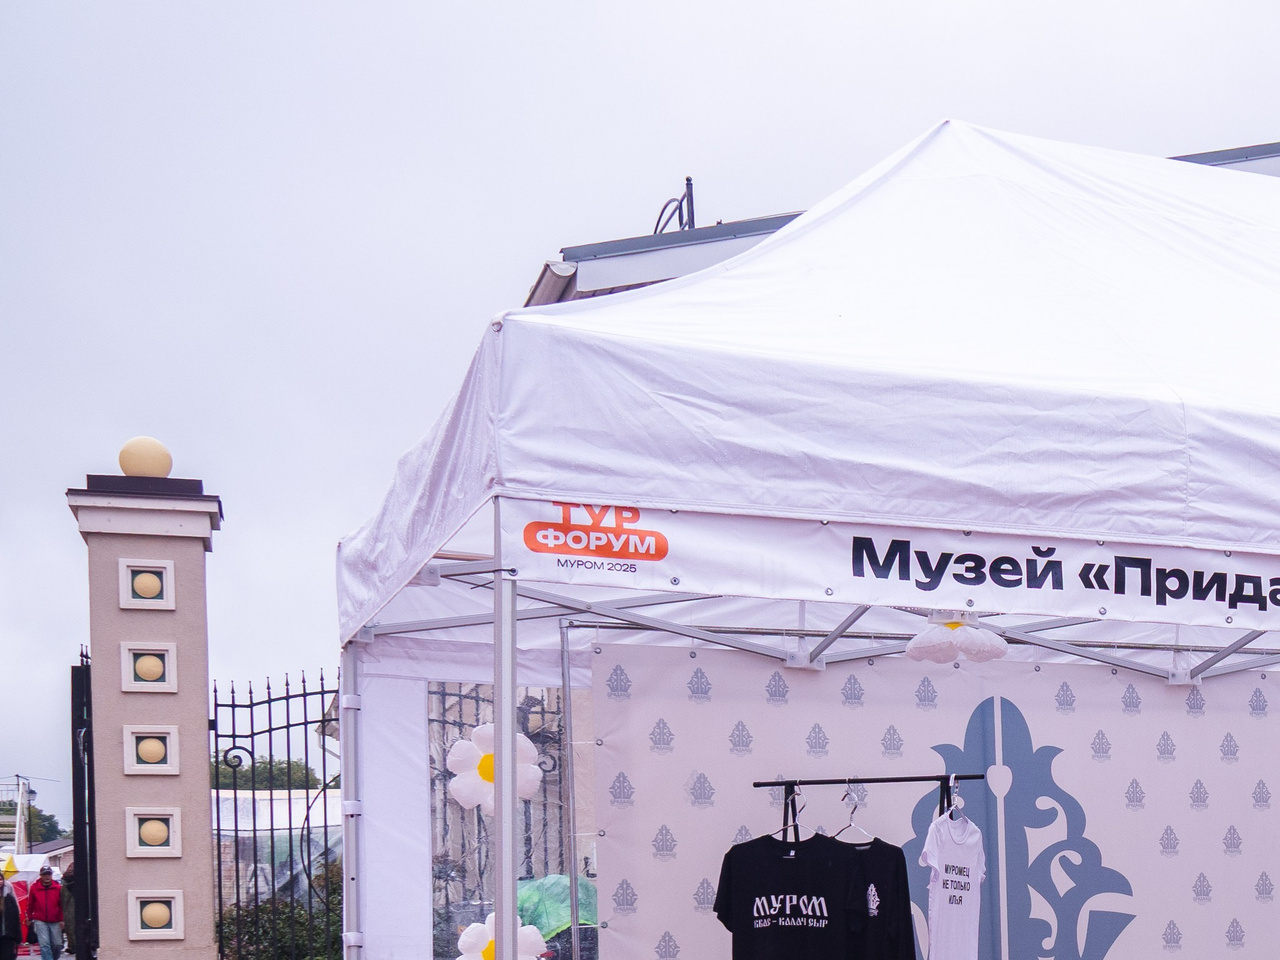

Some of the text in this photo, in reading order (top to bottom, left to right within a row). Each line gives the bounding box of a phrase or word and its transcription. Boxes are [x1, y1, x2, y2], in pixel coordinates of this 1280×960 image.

[552, 501, 641, 529] ТУР
[535, 528, 656, 554] ФОРУМ
[557, 558, 637, 573] МУРОМ 2025
[852, 536, 1064, 591] Музей
[945, 864, 970, 879] МУРОМЕЦ
[943, 879, 970, 891] НЕ ТОЛЬКО
[753, 895, 828, 917] МУРОМ
[779, 917, 807, 926] КАЛАЧ
[808, 918, 828, 928] СЫР
